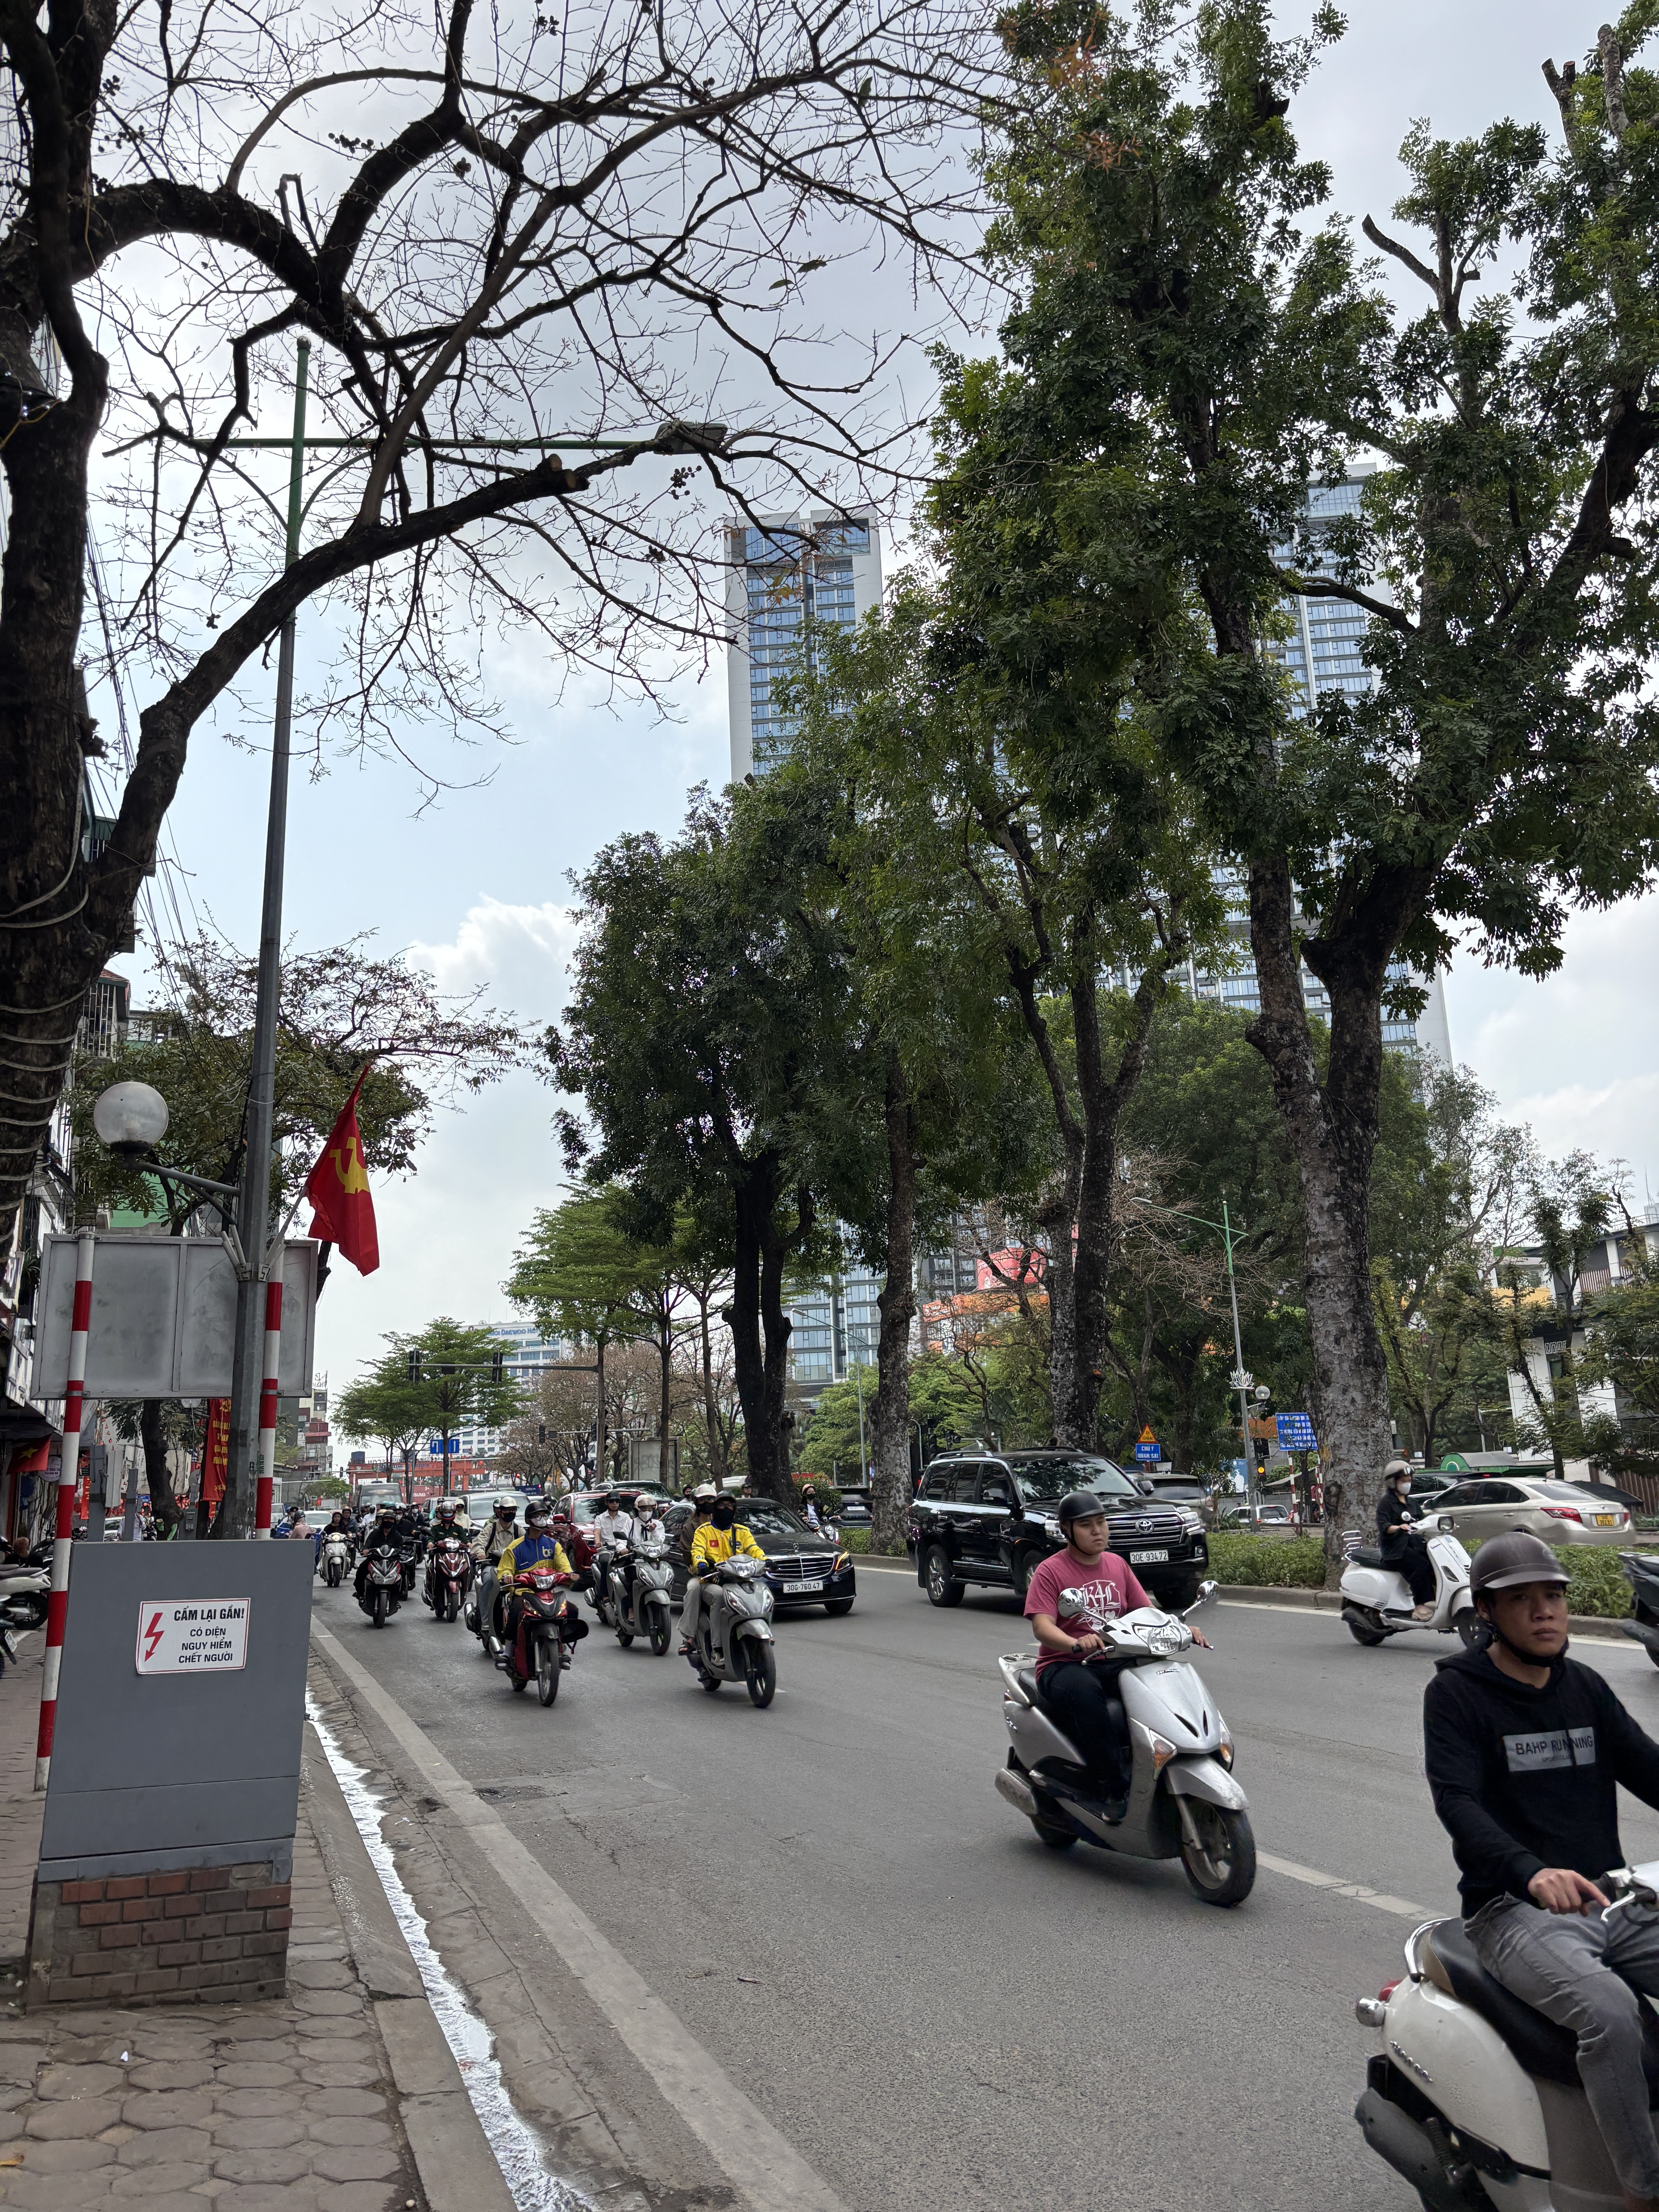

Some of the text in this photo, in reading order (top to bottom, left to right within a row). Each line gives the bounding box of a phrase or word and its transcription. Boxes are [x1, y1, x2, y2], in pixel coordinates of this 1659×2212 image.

[174, 1606, 198, 1621] CẤM
[201, 1609, 216, 1622] LẠI
[190, 1626, 226, 1638] CÓ ĐIỆN
[182, 1637, 232, 1650] NGUY HIỂM
[179, 1651, 233, 1663] CHẾT NGƯỜI
[1516, 1741, 1547, 1755] BAHP
